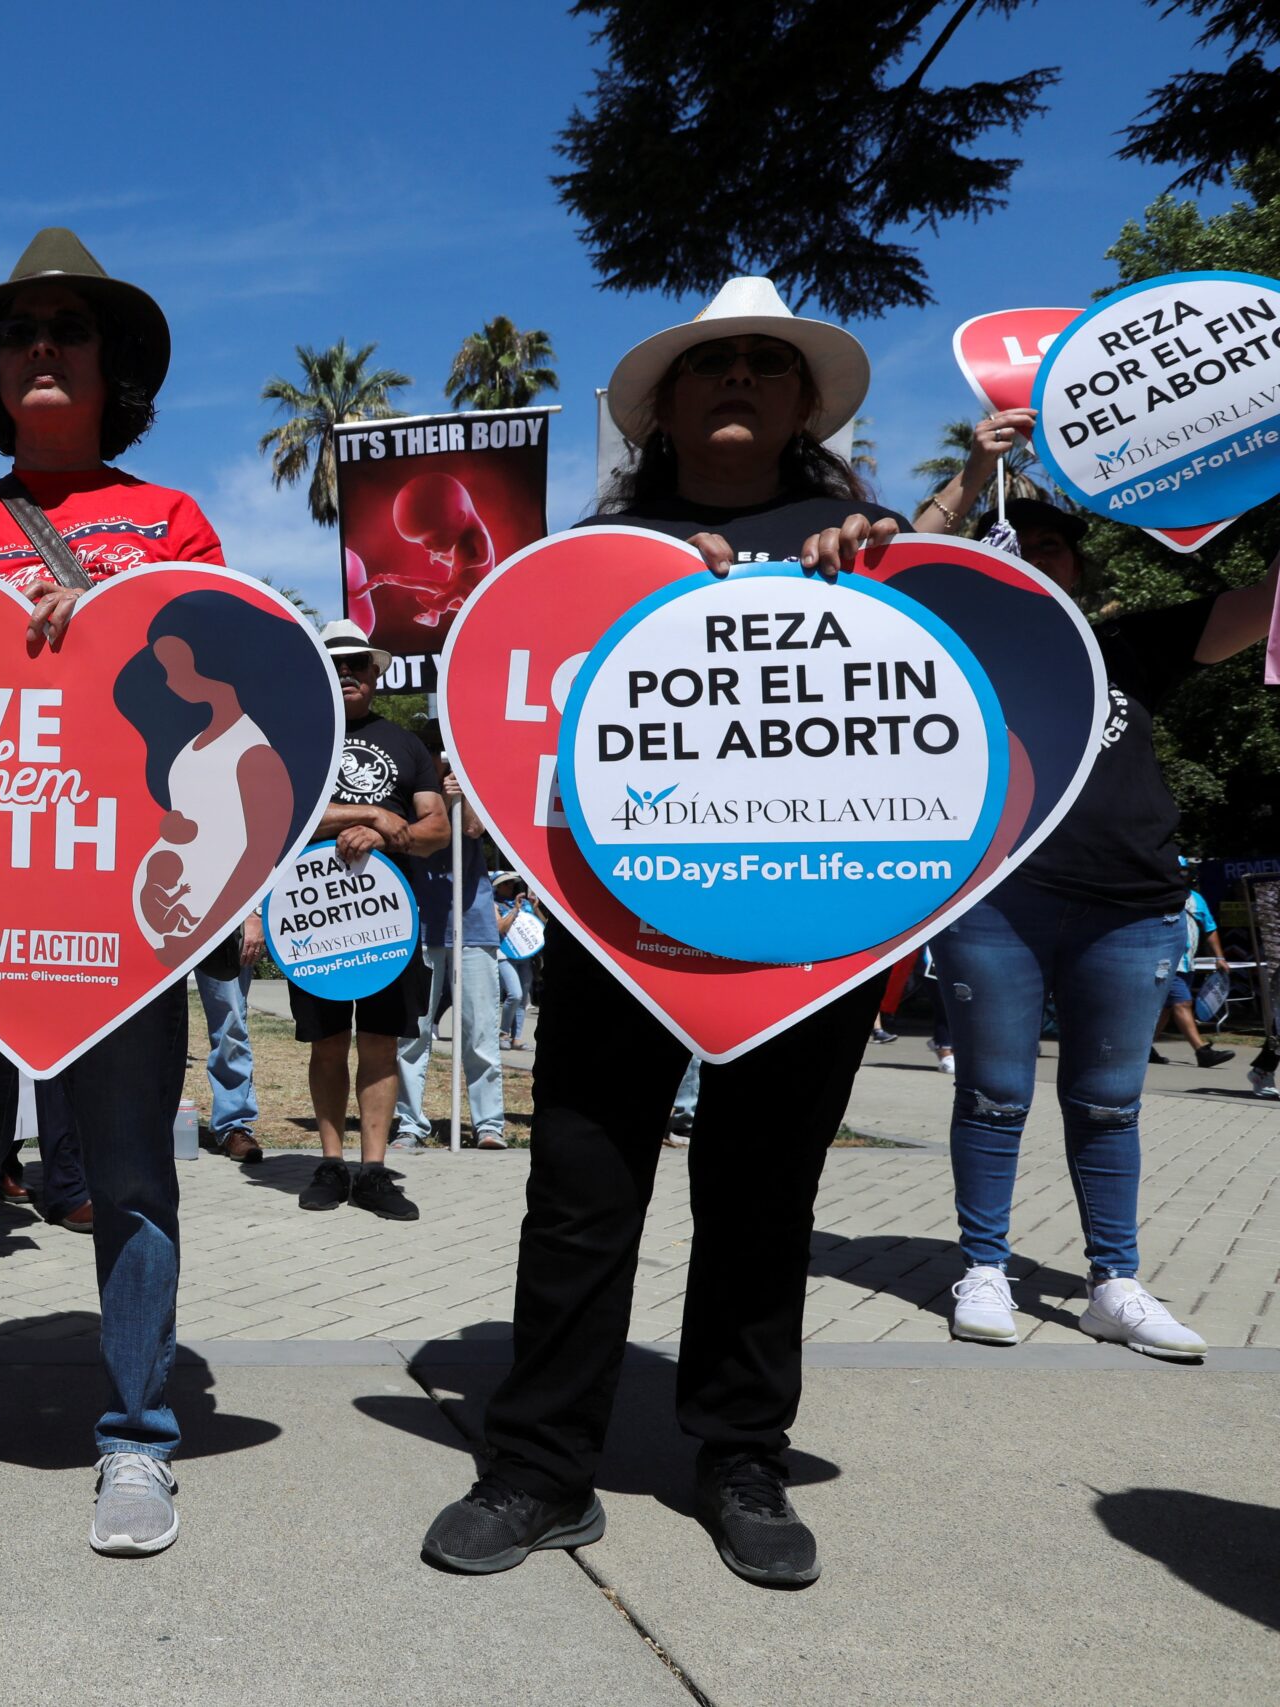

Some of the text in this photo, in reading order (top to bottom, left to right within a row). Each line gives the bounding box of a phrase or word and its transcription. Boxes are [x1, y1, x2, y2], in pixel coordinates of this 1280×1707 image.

[1098, 300, 1204, 357] REZA
[1064, 298, 1277, 410] POR EL FIN
[1059, 325, 1280, 449] DEL ABORT
[338, 417, 543, 462] IT'S THEIR BODY
[1093, 457, 1125, 481] 40
[1126, 431, 1180, 465] DÍAS
[705, 611, 852, 653] REZA
[628, 660, 937, 709] POR EL FIN
[344, 738, 366, 746] VES
[597, 713, 960, 762] DEL ABORTO
[1101, 716, 1128, 748] ICE
[340, 791, 361, 803] MY
[611, 798, 659, 831] 40
[663, 791, 738, 825] DÍAS
[286, 873, 376, 908] TO END
[612, 852, 952, 889] 40DaysForLife.com
[279, 892, 399, 936] ABORTION
[32, 933, 117, 965] ACTION
[309, 937, 341, 955] DAYS
[371, 924, 404, 942] LIFE
[30, 970, 118, 986] @liveactionorg
[292, 948, 408, 978] 40DaysForLife.com
